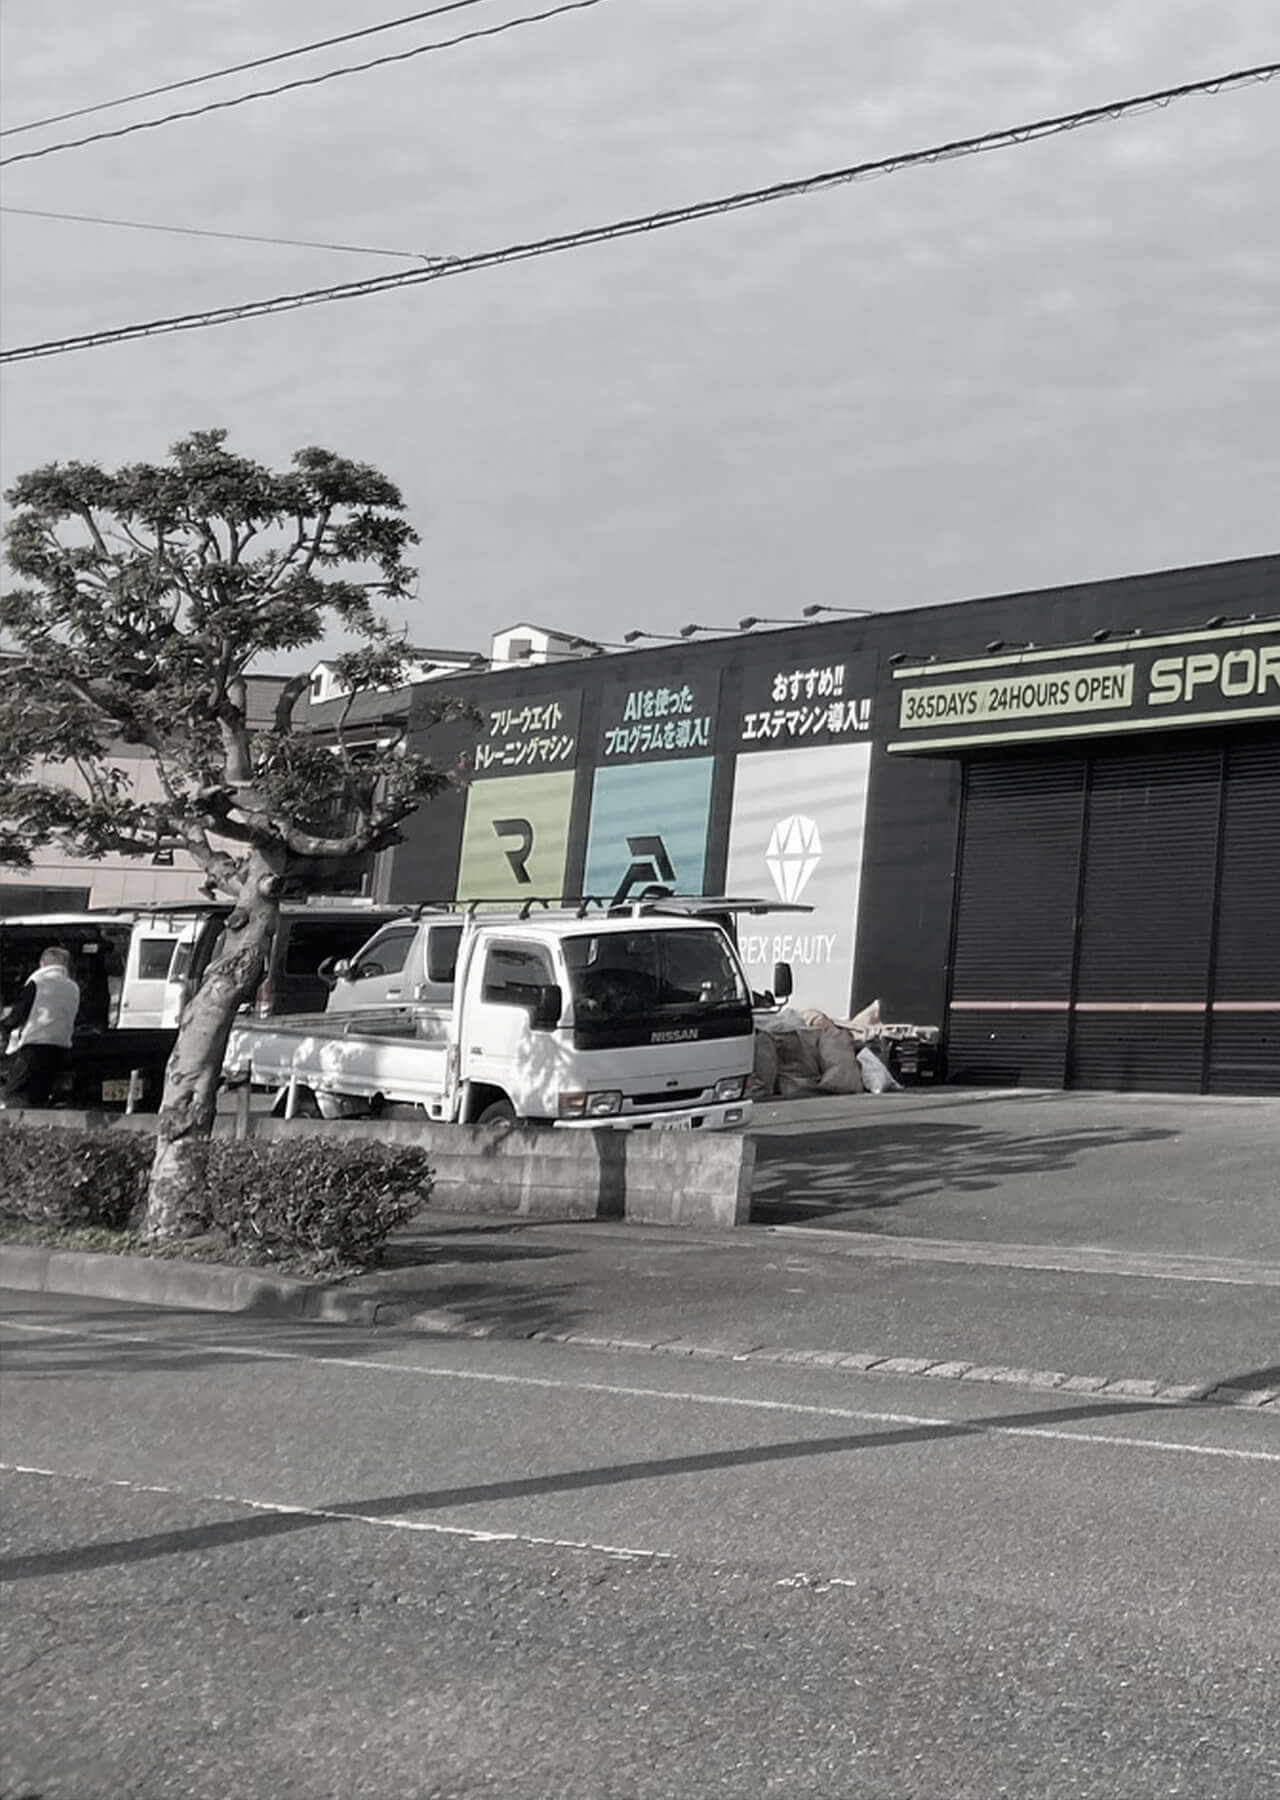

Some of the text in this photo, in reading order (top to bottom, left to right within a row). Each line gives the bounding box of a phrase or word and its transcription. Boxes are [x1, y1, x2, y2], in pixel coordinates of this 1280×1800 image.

[623, 685, 694, 722] AIを使った
[906, 690, 977, 721] 365DAYS
[988, 680, 1070, 712] 24HOURS
[1075, 674, 1126, 703] OPEN
[474, 735, 574, 770] トレーニングマシン
[605, 717, 711, 756] プログラムを導入!
[738, 934, 836, 965] REX BEAUTY
[650, 1028, 699, 1043] NISSAN
